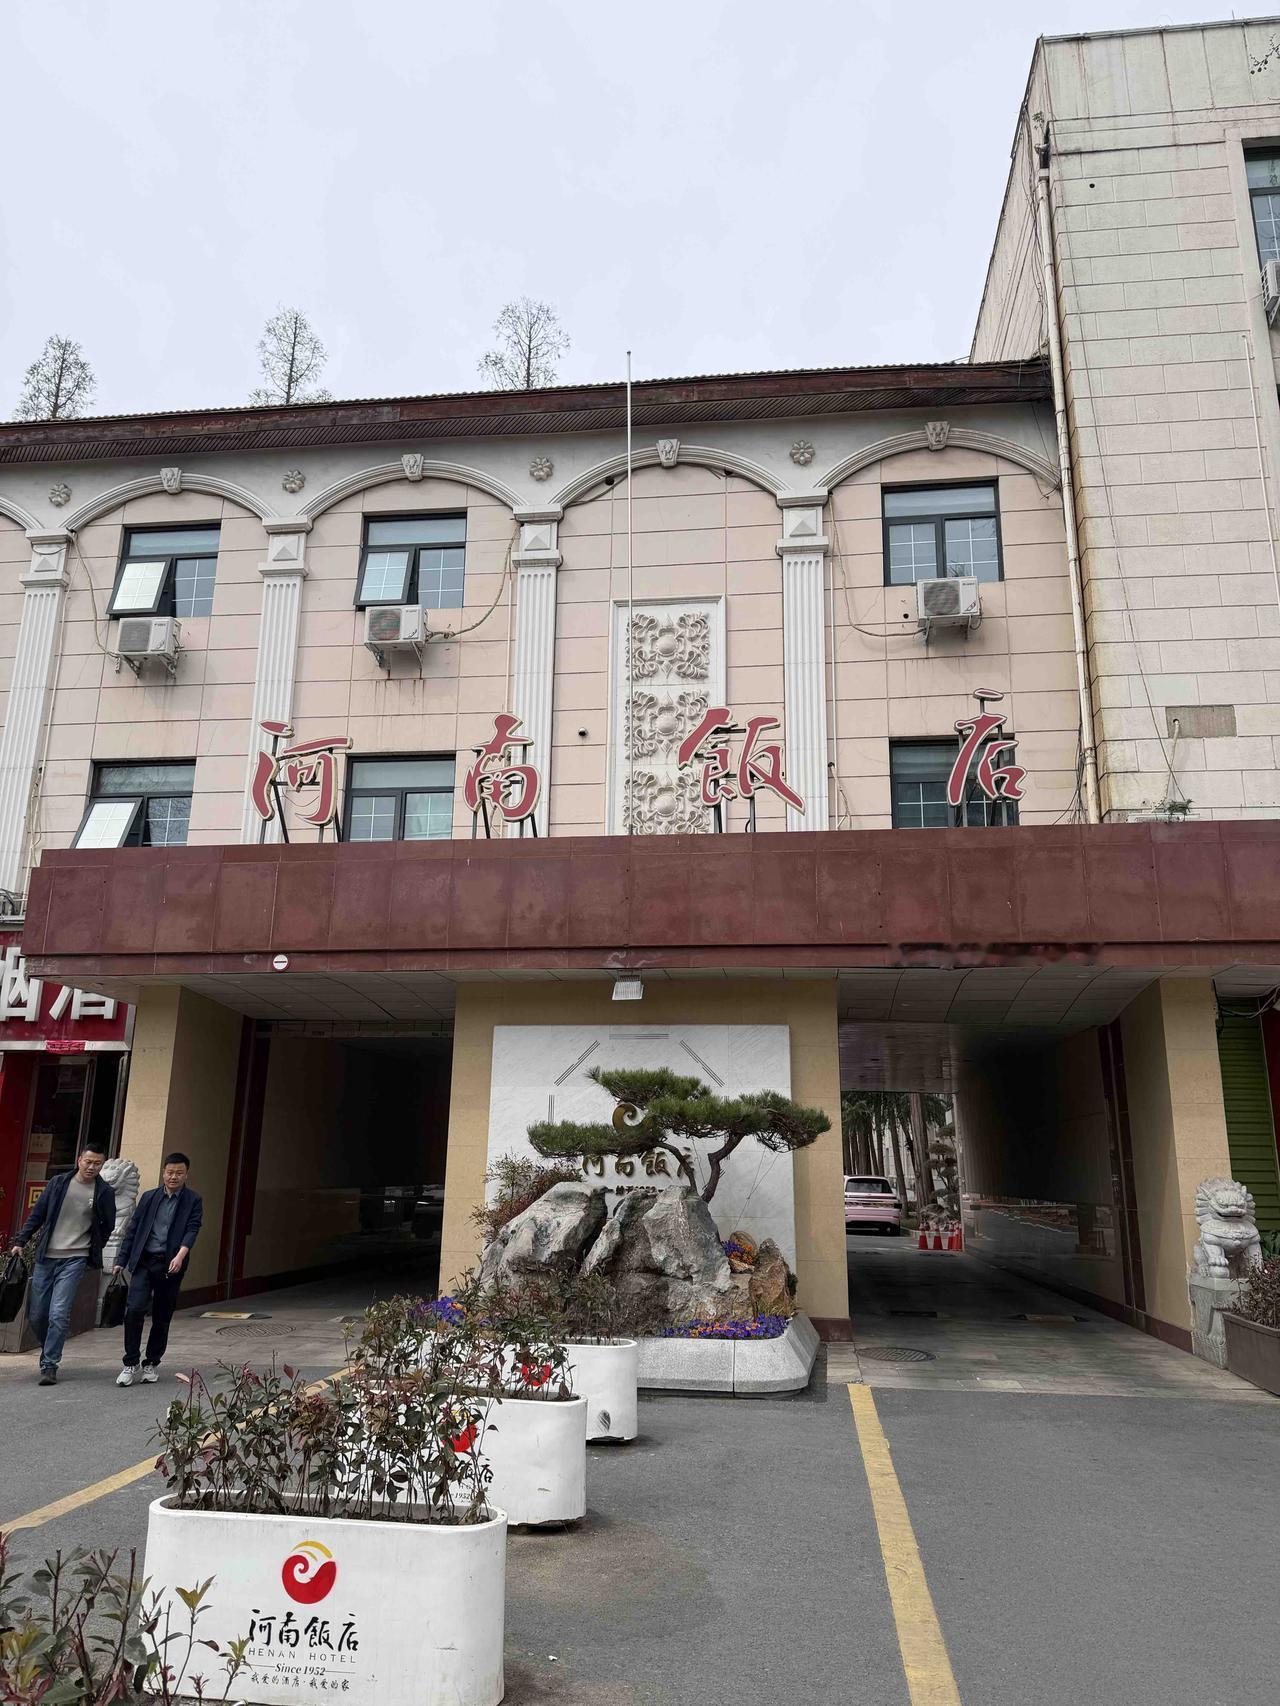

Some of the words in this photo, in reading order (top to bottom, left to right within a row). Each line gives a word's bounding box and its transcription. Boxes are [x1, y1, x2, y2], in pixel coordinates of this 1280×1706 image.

[248, 1647, 297, 1660] HENAN
[309, 1652, 357, 1664] HOTEL
[275, 1663, 302, 1675] Since
[303, 1665, 327, 1677] 1952
